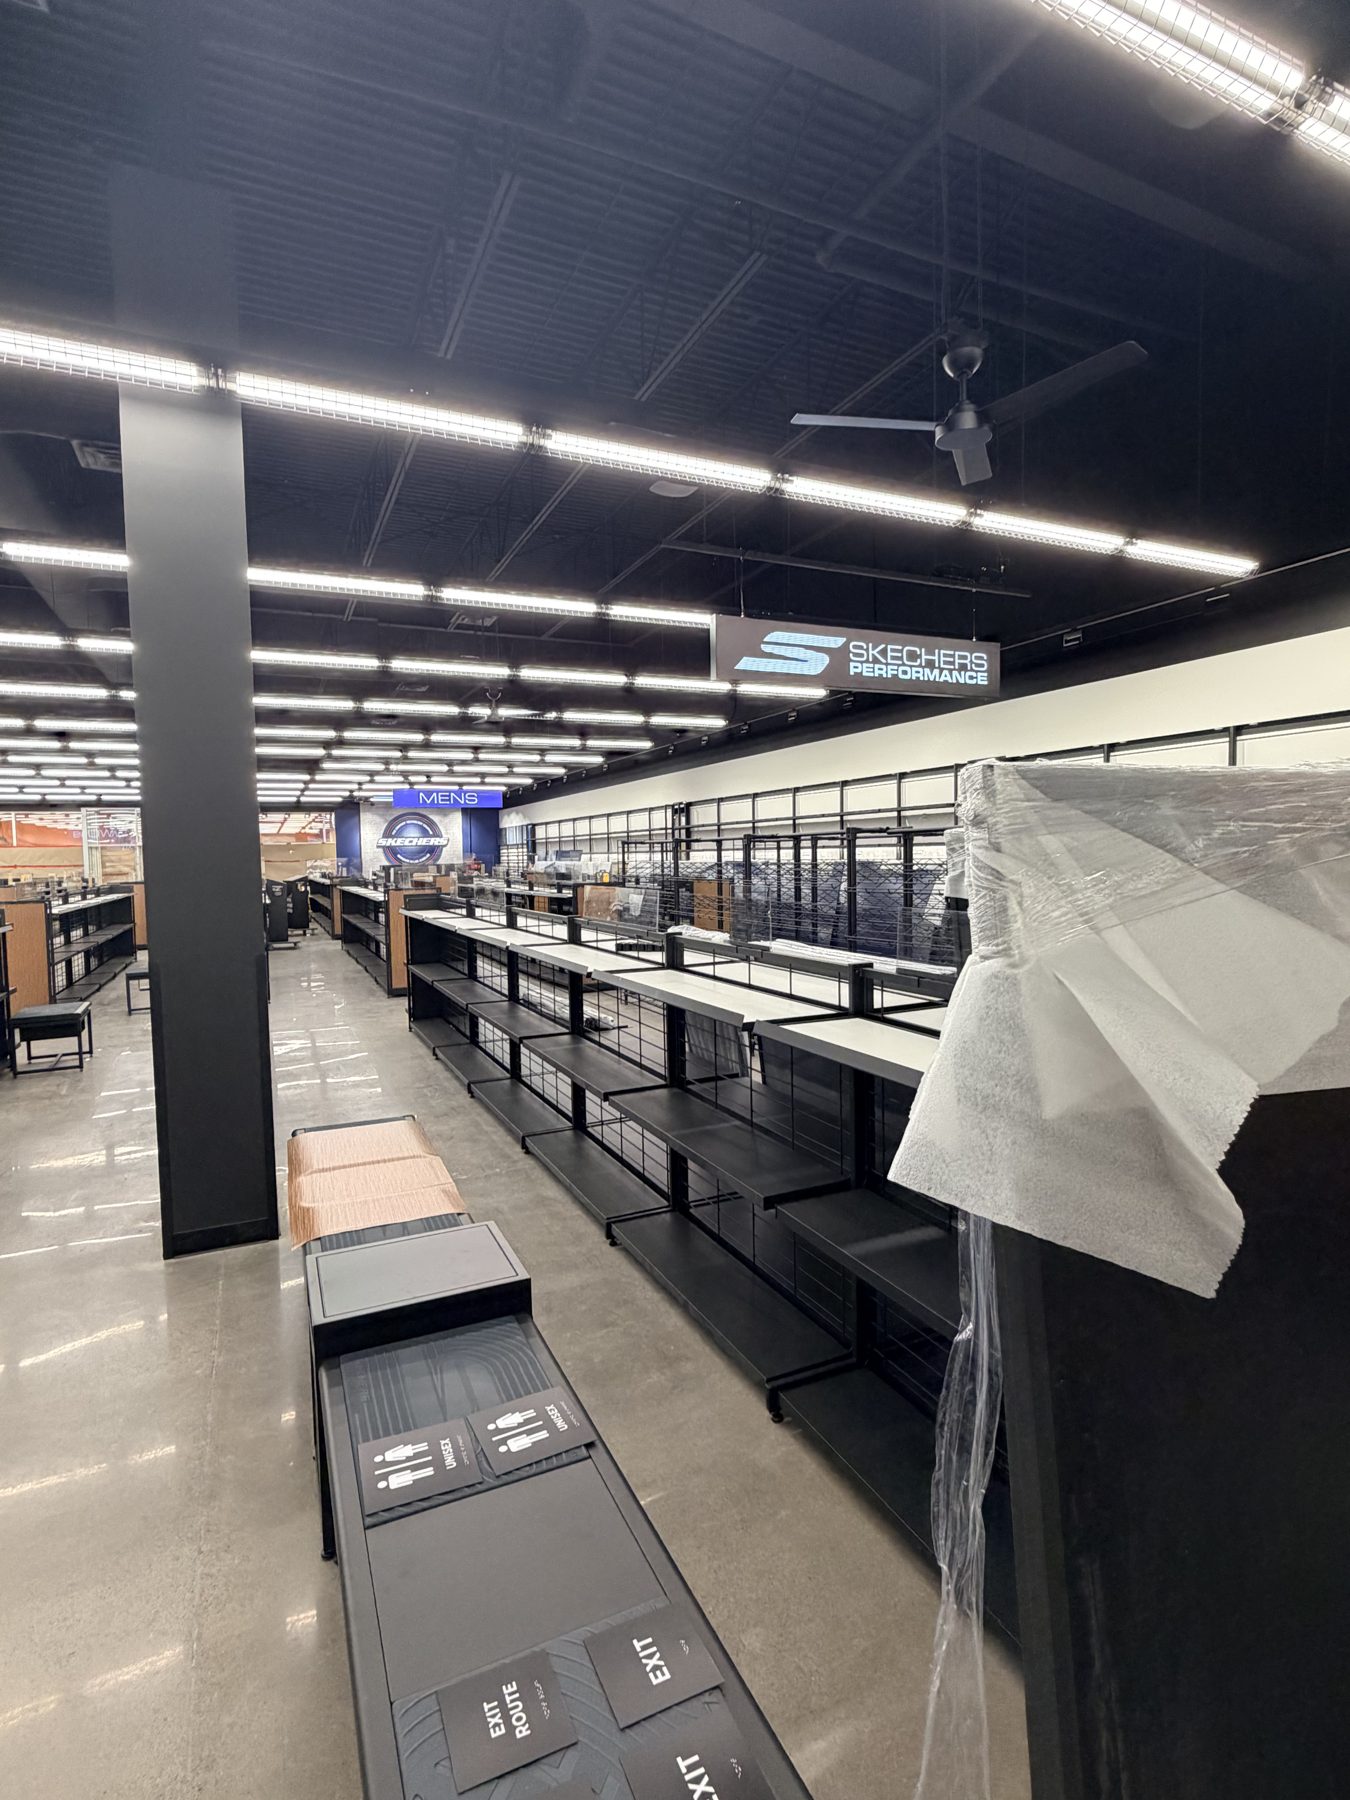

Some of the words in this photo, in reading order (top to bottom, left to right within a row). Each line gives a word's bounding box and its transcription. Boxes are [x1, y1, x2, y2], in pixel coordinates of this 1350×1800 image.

[848, 641, 989, 672] SKECHERS
[849, 662, 989, 686] PERFORMANCE
[419, 792, 478, 804] MENS
[377, 837, 449, 847] SKECHERS
[544, 1403, 569, 1432] UNISEX
[439, 1437, 457, 1470] UNISEX
[632, 1636, 671, 1686] EXIT
[482, 1700, 506, 1739] EXIT
[501, 1680, 532, 1740] ROUTE
[675, 1754, 720, 1800] XIT
